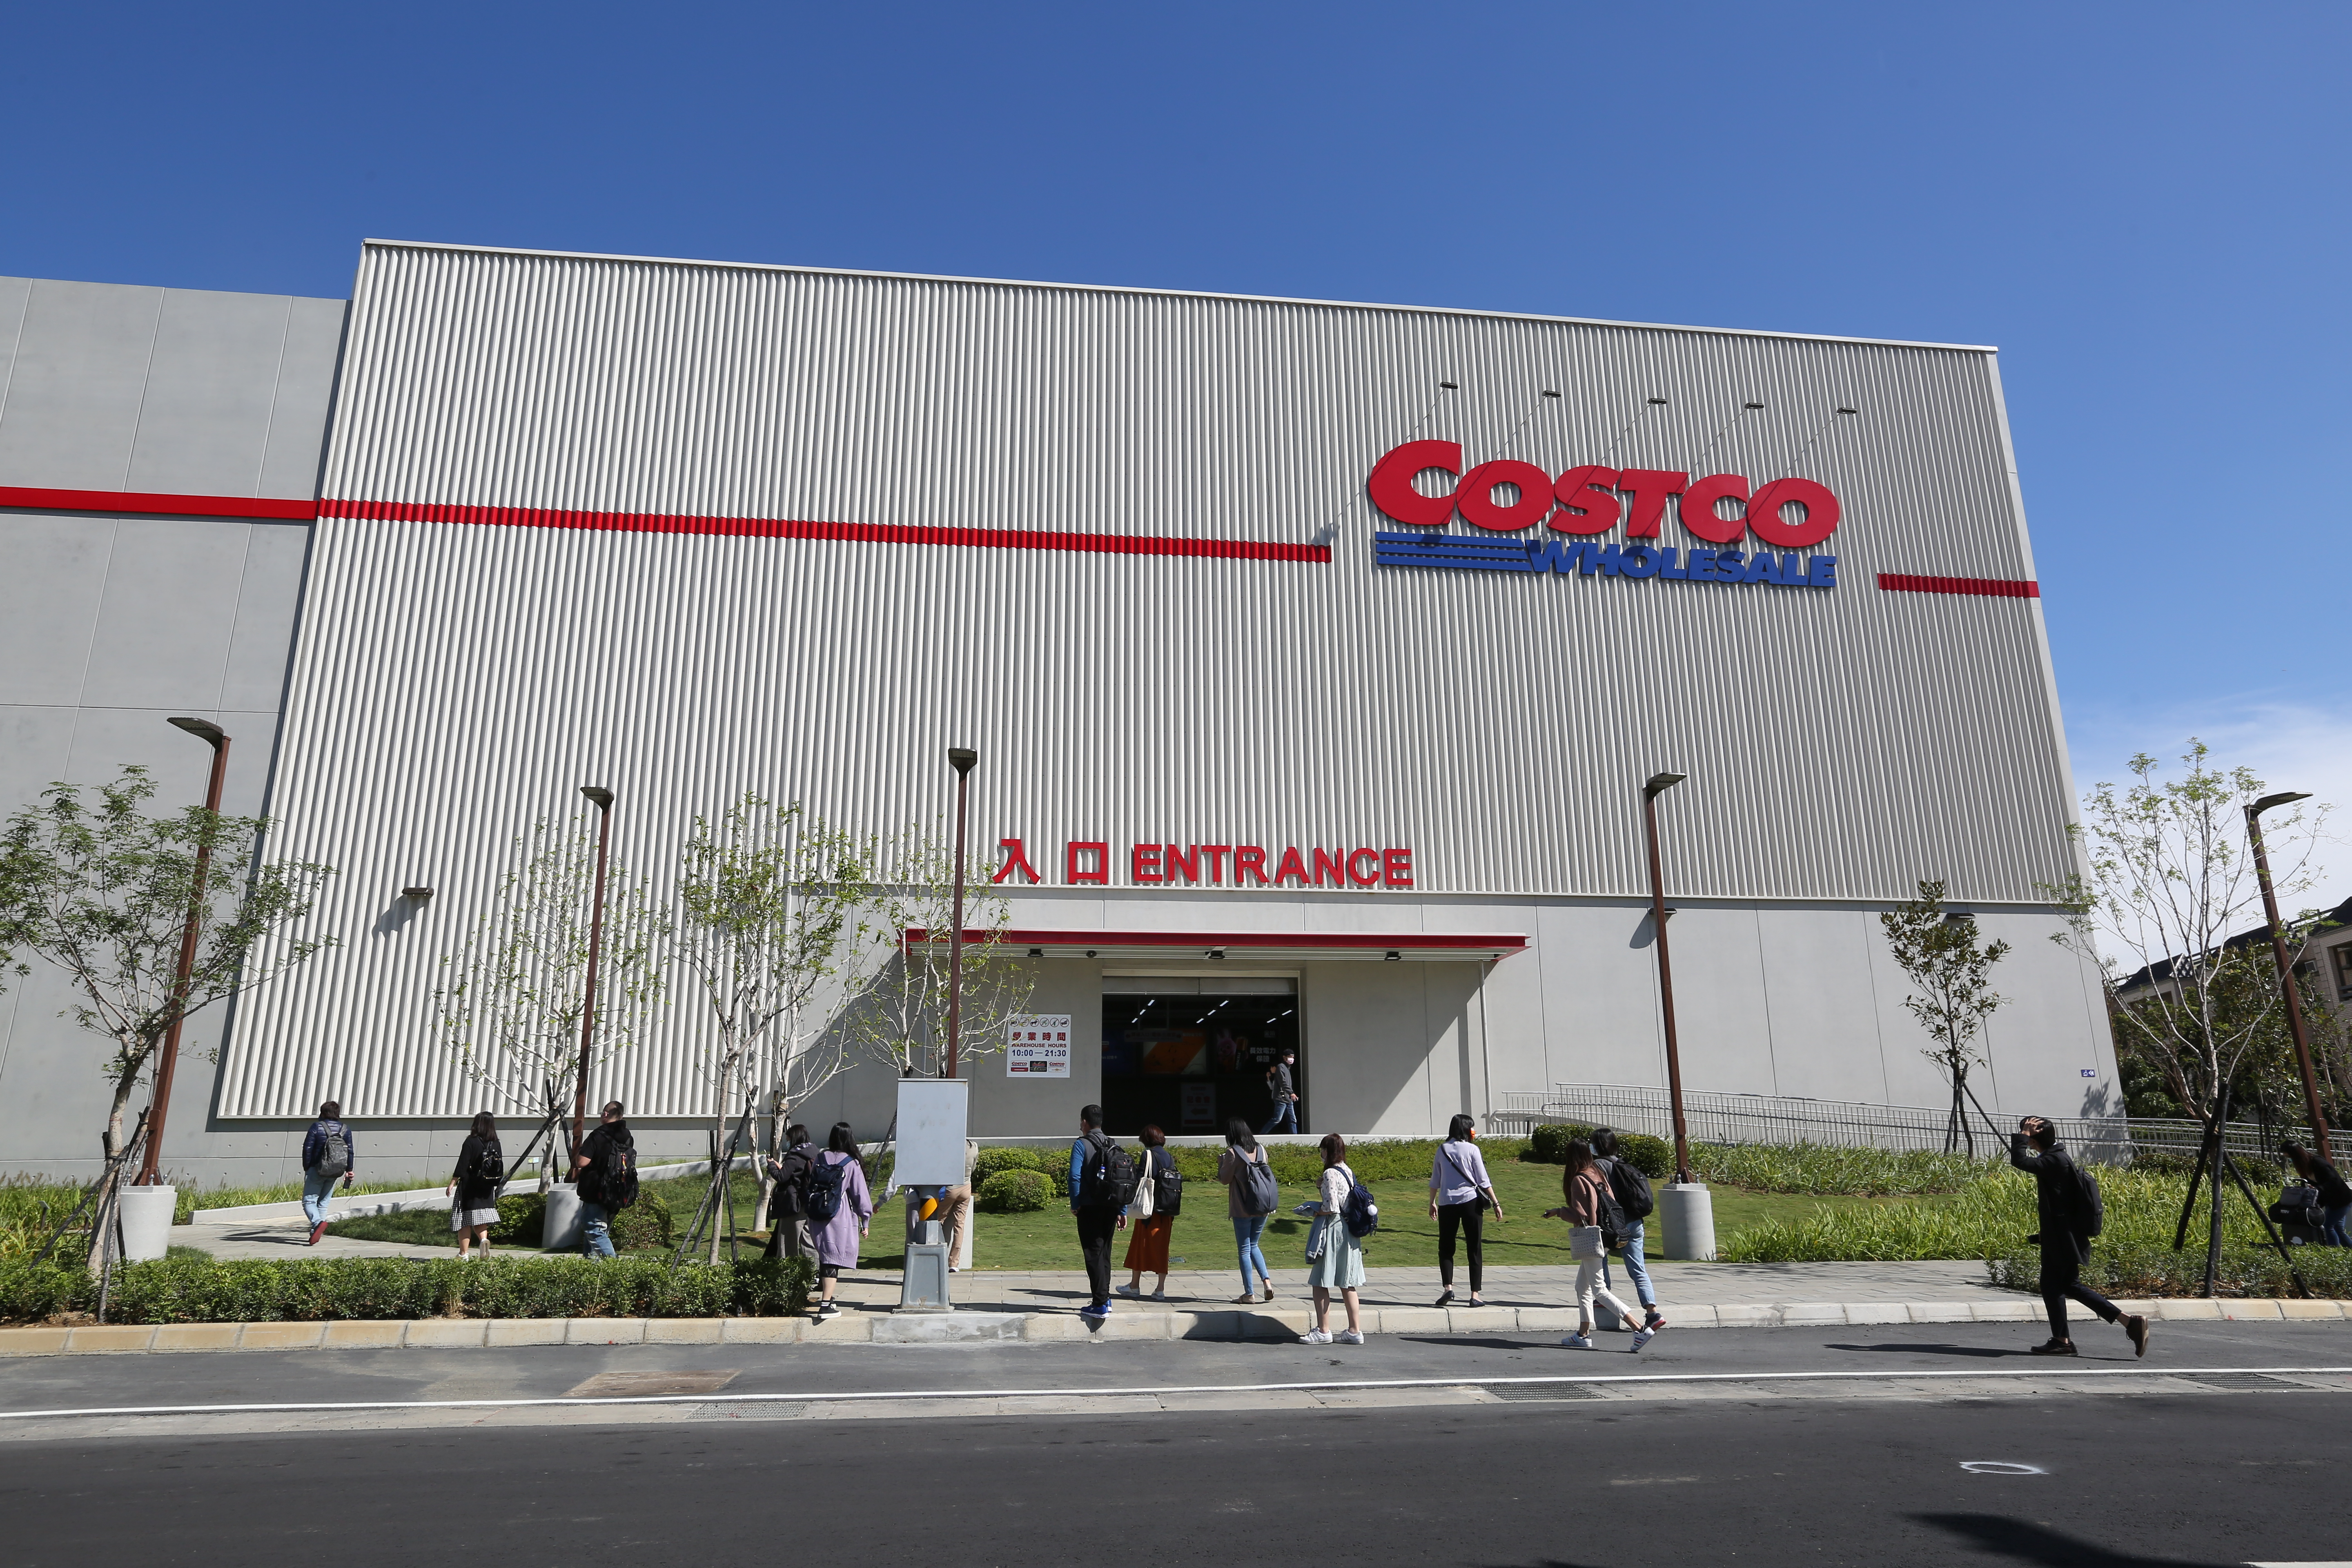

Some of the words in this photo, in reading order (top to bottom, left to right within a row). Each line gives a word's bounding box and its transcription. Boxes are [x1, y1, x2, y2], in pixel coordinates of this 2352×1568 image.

[1369, 440, 1840, 547] COSTCO
[1525, 539, 1837, 587] WHOLESALE
[993, 839, 1108, 884] 入口
[1134, 844, 1413, 885] ENTRANCE
